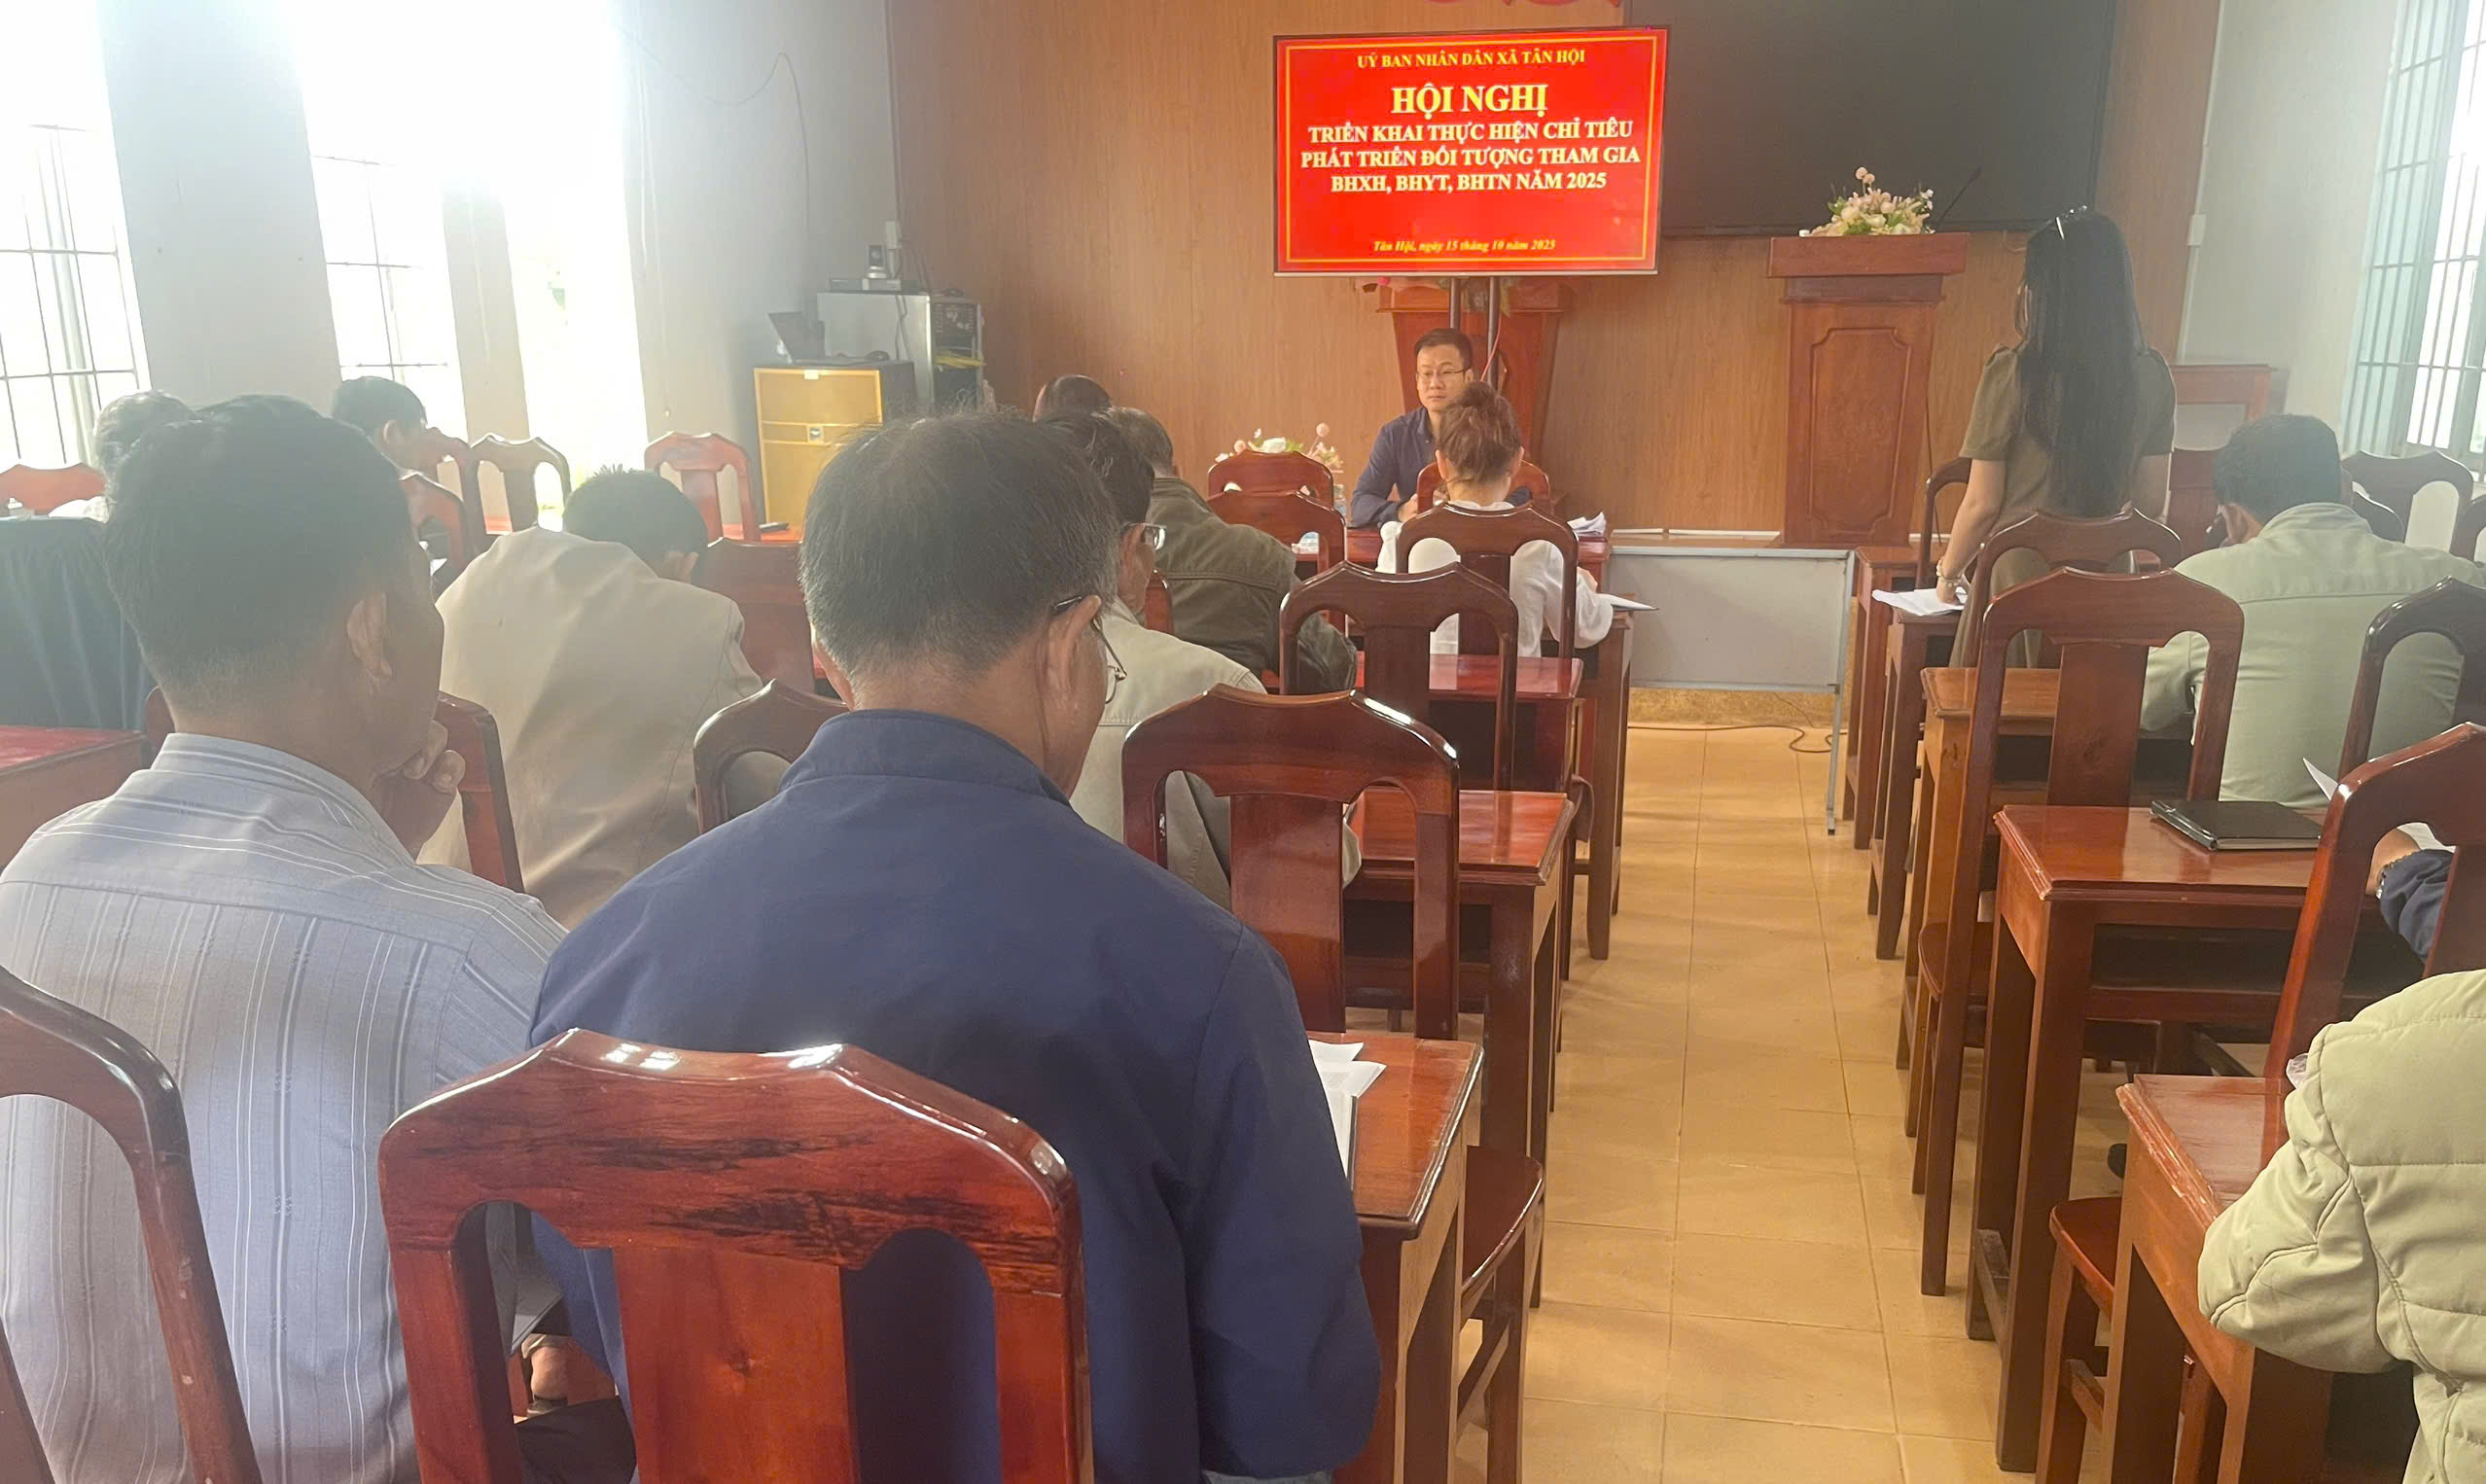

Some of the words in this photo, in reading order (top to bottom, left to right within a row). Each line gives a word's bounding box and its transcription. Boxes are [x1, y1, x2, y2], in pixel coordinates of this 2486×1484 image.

[1382, 54, 1411, 68] BAN
[1415, 50, 1458, 66] NHÂN
[1462, 49, 1493, 66] DÂN
[1497, 49, 1517, 64] XÃ
[1521, 48, 1552, 63] TÂN
[1556, 48, 1585, 65] HỘI
[1390, 83, 1454, 120] HỘI
[1460, 84, 1548, 117] NGHỊ
[1308, 121, 1368, 143] TRIỂN
[1372, 124, 1423, 142] KHAI
[1427, 122, 1485, 144] THỰC
[1488, 121, 1539, 144] HIỆN
[1543, 117, 1580, 139] CHỈ
[1584, 117, 1634, 139] TIÊU
[1300, 147, 1354, 168] PHÁT
[1357, 146, 1416, 167] TRIỂN
[1421, 145, 1457, 166] ĐỐI
[1462, 146, 1534, 169] TƯỢNG
[1538, 148, 1599, 164] THAM
[1603, 147, 1641, 163] GIA
[1331, 175, 1392, 194] BHXH,
[1396, 174, 1453, 194] BHYT,
[1457, 173, 1511, 191] BHTN
[1516, 169, 1563, 190] NĂM
[1567, 172, 1607, 189] 2025
[1446, 240, 1458, 252] 15
[1492, 240, 1505, 250] 10
[1506, 241, 1529, 250] năm
